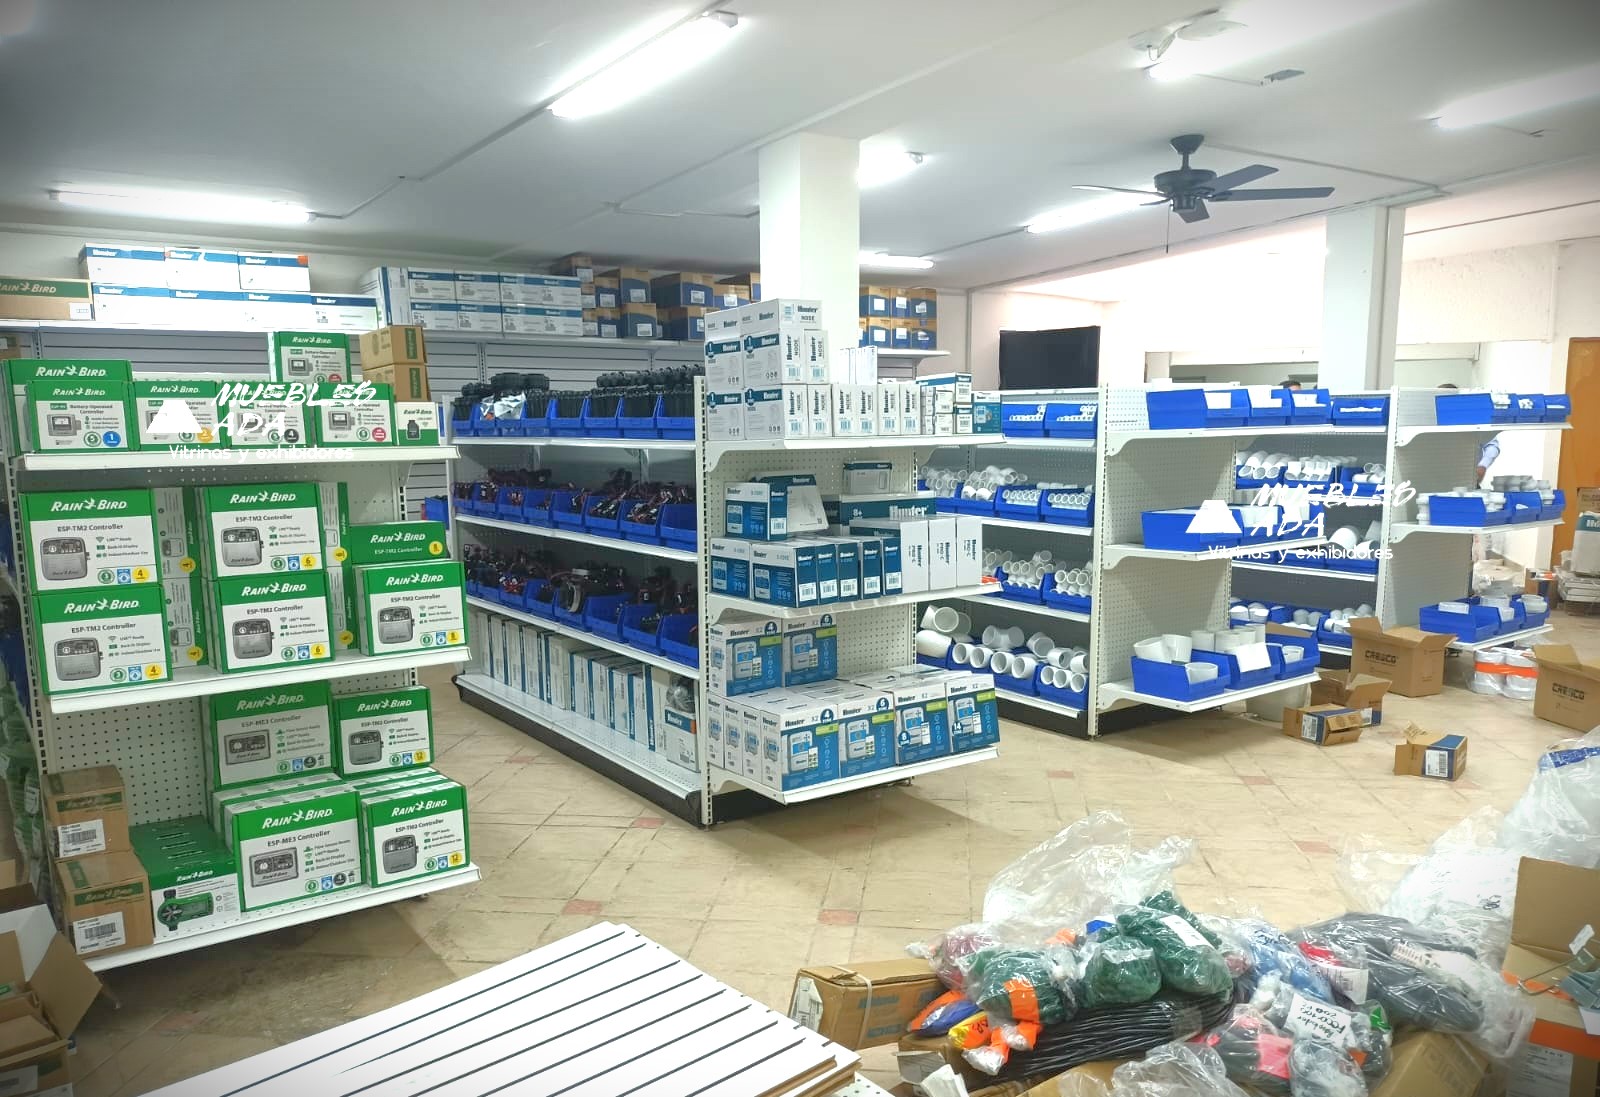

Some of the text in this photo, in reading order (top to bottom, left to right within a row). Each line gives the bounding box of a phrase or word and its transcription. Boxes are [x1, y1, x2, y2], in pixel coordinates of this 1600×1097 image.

[31, 285, 57, 294] BIRD
[36, 366, 107, 378] RAIN BIRD
[52, 388, 107, 397] RAIN BIRD
[150, 386, 172, 394] RAIN
[230, 492, 297, 504] RAIN BIRD
[51, 499, 128, 512] RAIN BIRD
[236, 513, 293, 523] ESP-TM2 Controller
[853, 508, 863, 516] 8+
[889, 505, 928, 520] Hunter
[89, 523, 123, 531] Controller
[370, 533, 426, 544] RAIN BIRD
[386, 574, 444, 587] RAIN BIRD
[242, 583, 308, 597] RAIN BIRD
[64, 599, 140, 614] RAIN BIRD
[274, 603, 304, 613] Controller
[72, 622, 136, 634] ESP-TM2 Controller
[151, 665, 157, 674] 4
[236, 694, 304, 712] RAIN BIRD
[357, 699, 412, 713] RAIN BIRD
[271, 714, 302, 724] Controller
[384, 717, 409, 725] Controller
[392, 799, 449, 817] RAIN BIRD
[261, 808, 334, 830] RAIN BIRD
[418, 819, 444, 828] Controller
[267, 830, 331, 847] ESP-ME3 Controller
